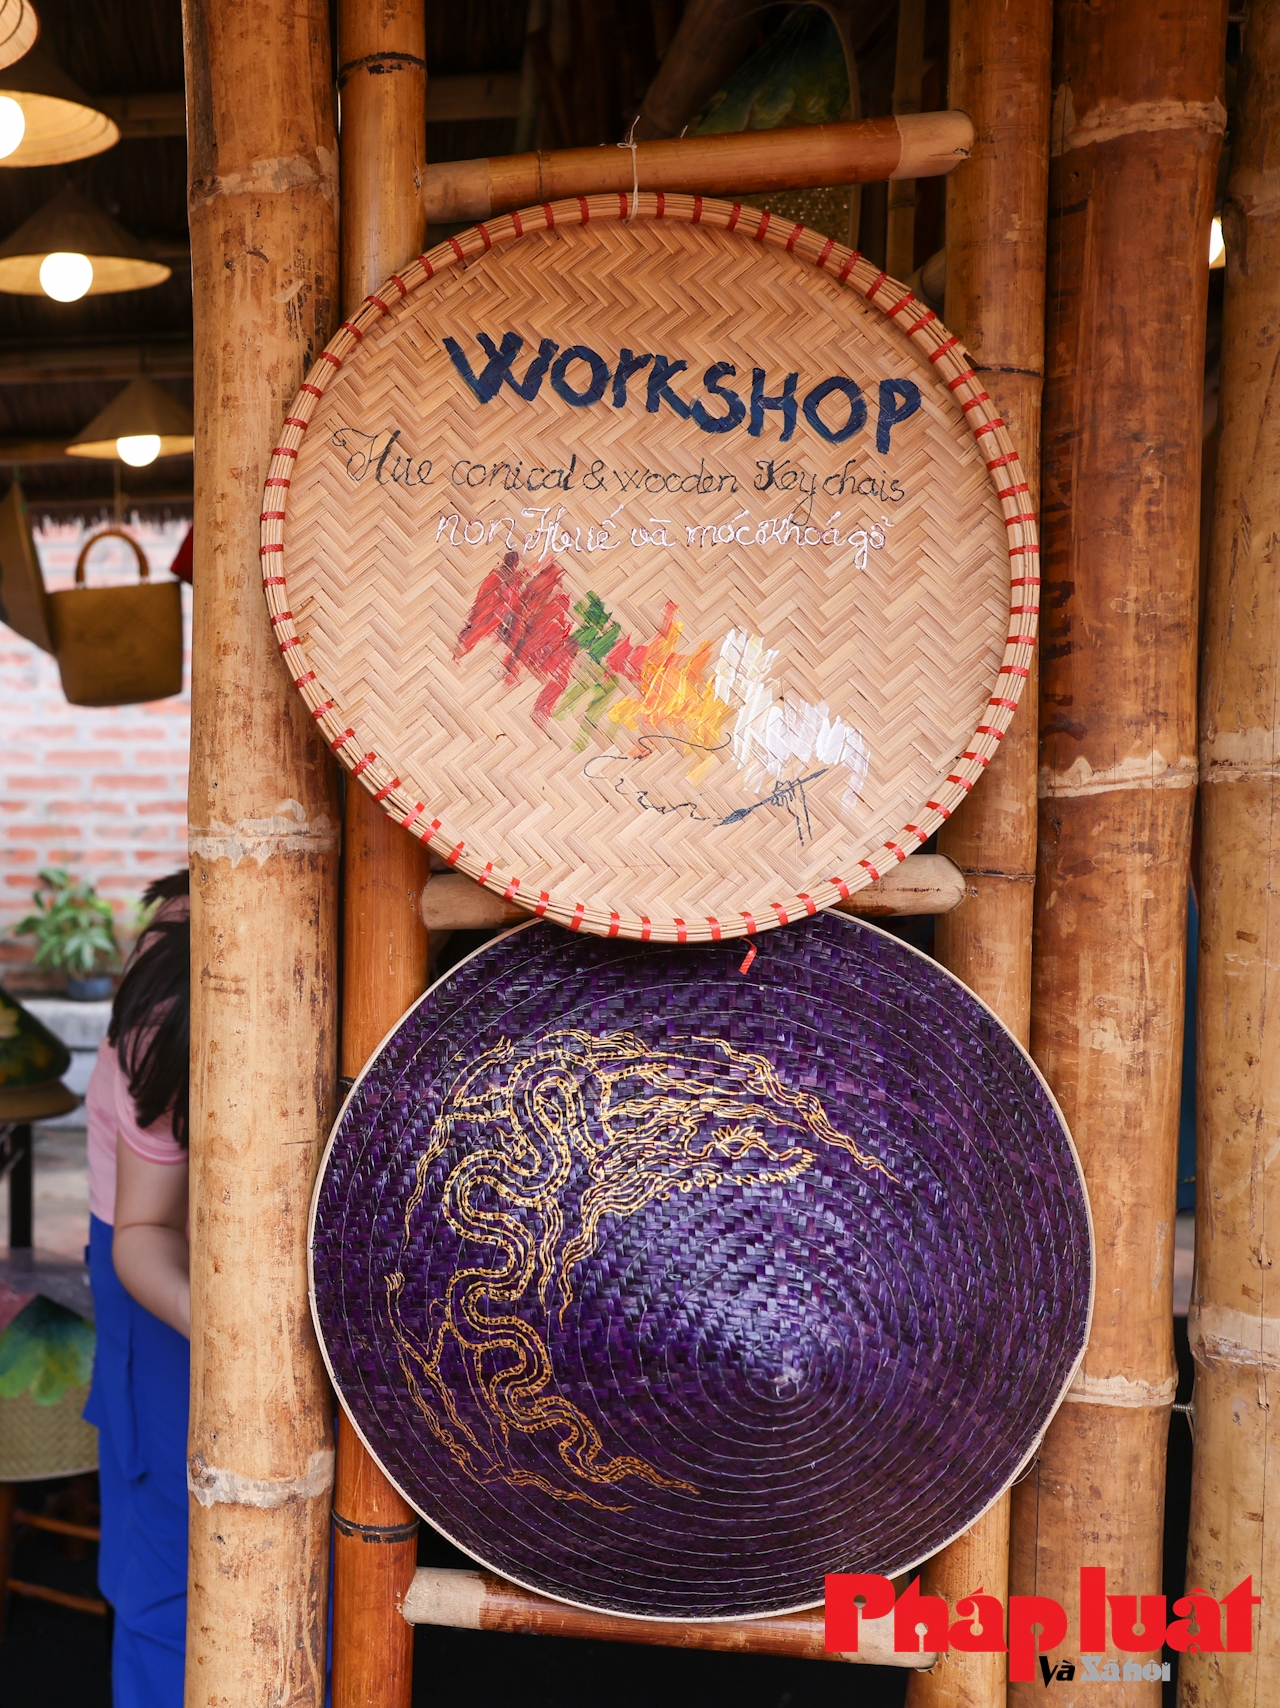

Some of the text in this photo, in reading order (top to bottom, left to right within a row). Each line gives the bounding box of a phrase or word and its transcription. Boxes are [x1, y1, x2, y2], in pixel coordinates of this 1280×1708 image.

[331, 427, 436, 486] Hue
[451, 453, 577, 491] conical
[582, 459, 609, 491] &
[613, 457, 739, 494] wooden
